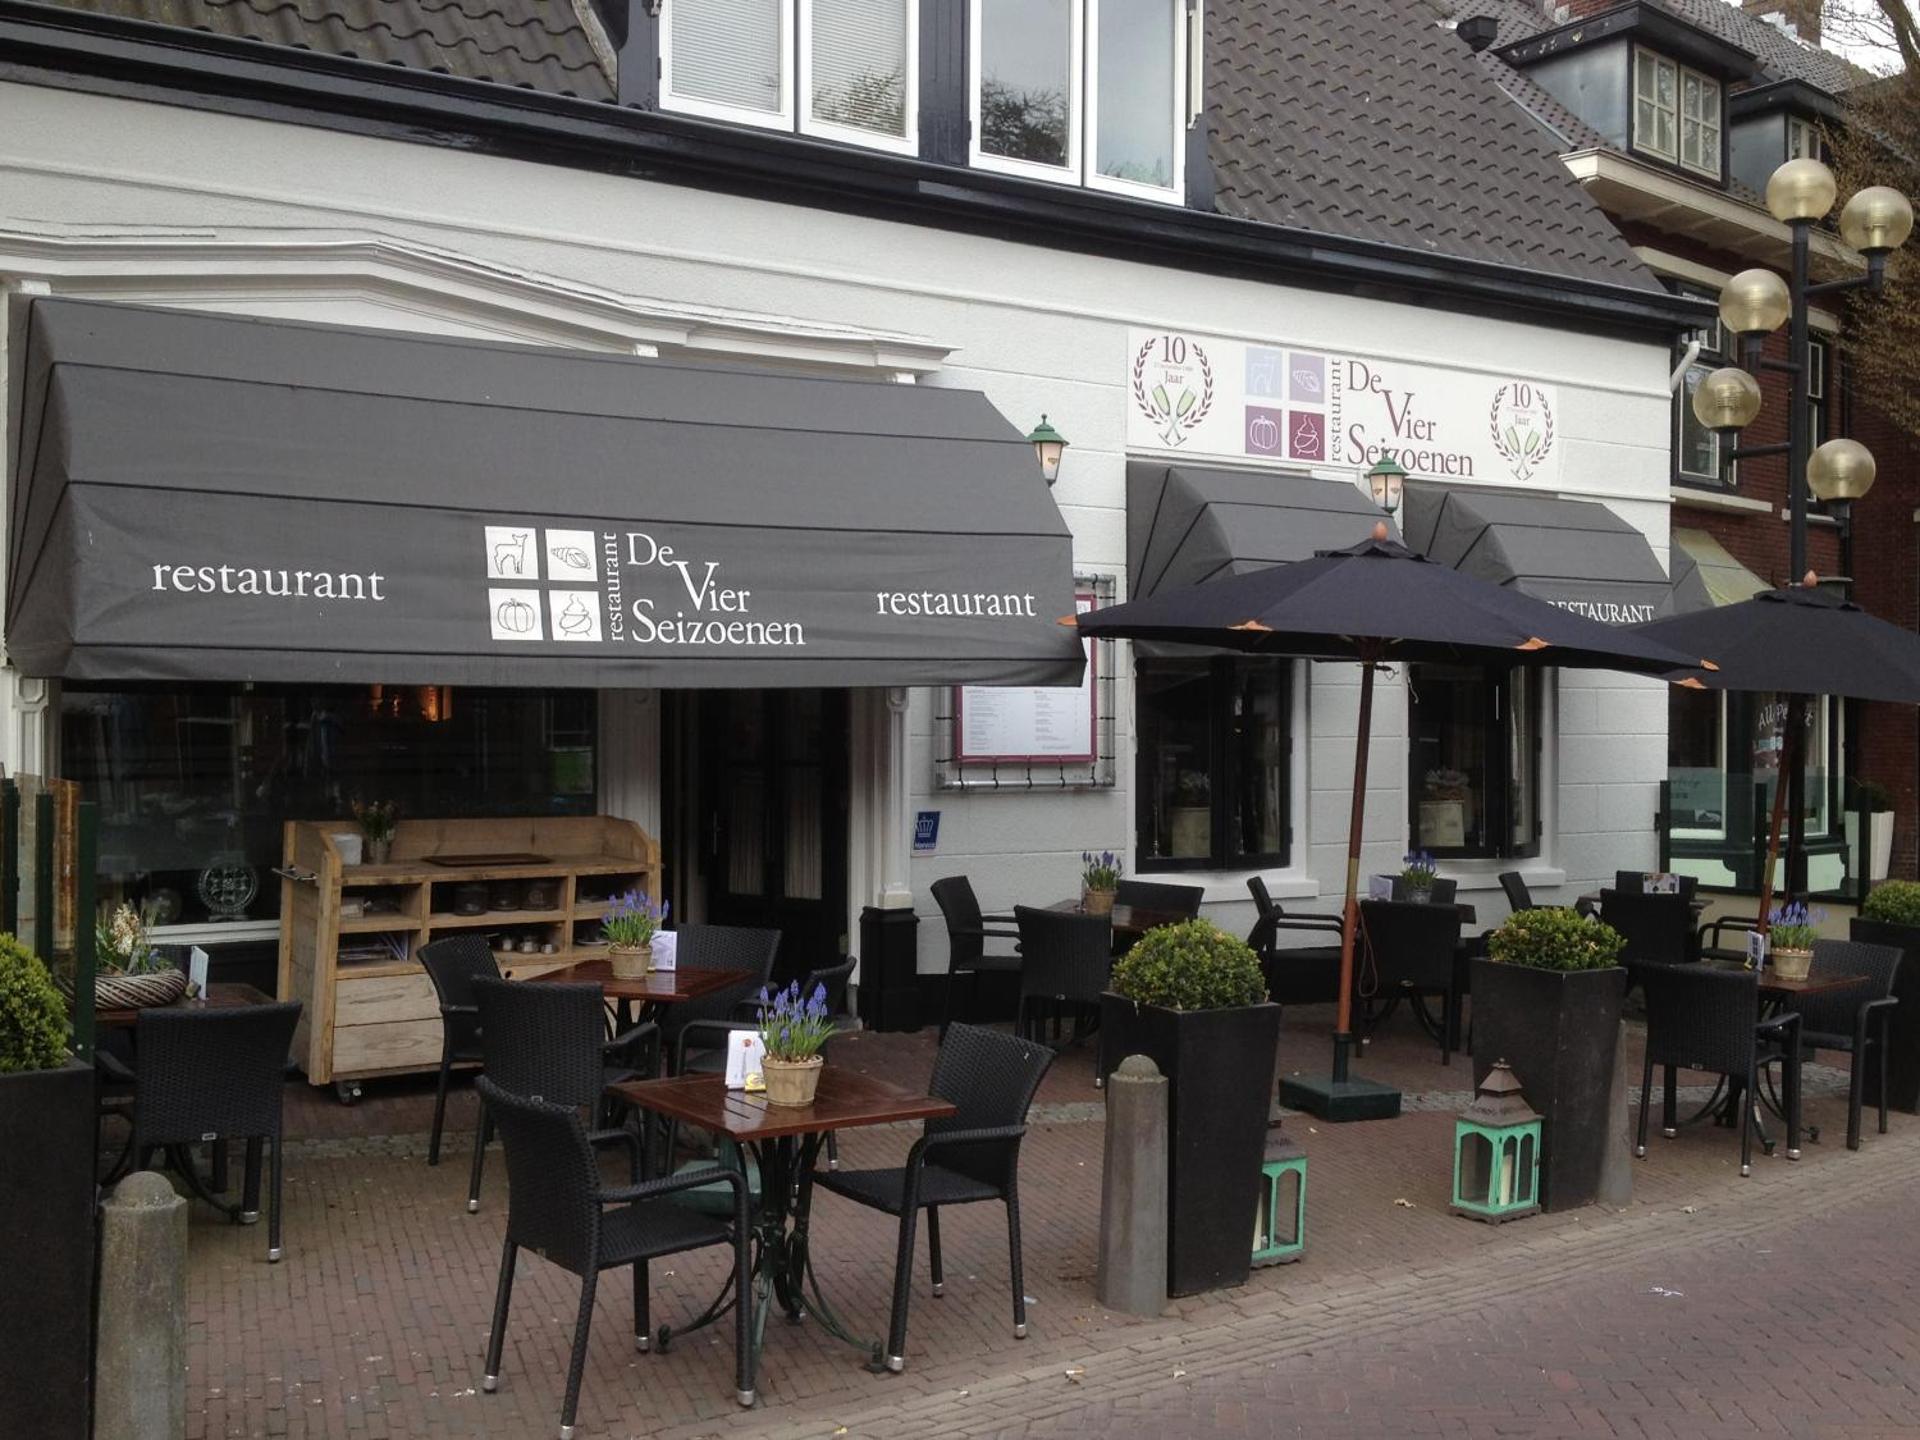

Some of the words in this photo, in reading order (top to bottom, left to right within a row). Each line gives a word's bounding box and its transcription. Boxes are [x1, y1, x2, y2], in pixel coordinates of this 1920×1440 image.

[1161, 335, 1186, 364] 10
[1165, 370, 1184, 384] Jaar
[1347, 360, 1382, 394] De
[1331, 359, 1342, 462] restaurant
[1512, 383, 1531, 408] 10
[1381, 389, 1437, 442] Vier
[626, 532, 676, 567] De
[151, 561, 386, 602] restaurant
[602, 531, 625, 642] restaurant
[673, 560, 751, 613] Vier
[876, 589, 1037, 617] restaurant
[1546, 600, 1655, 623] STAURANT
[631, 599, 807, 646] Seizoenen
